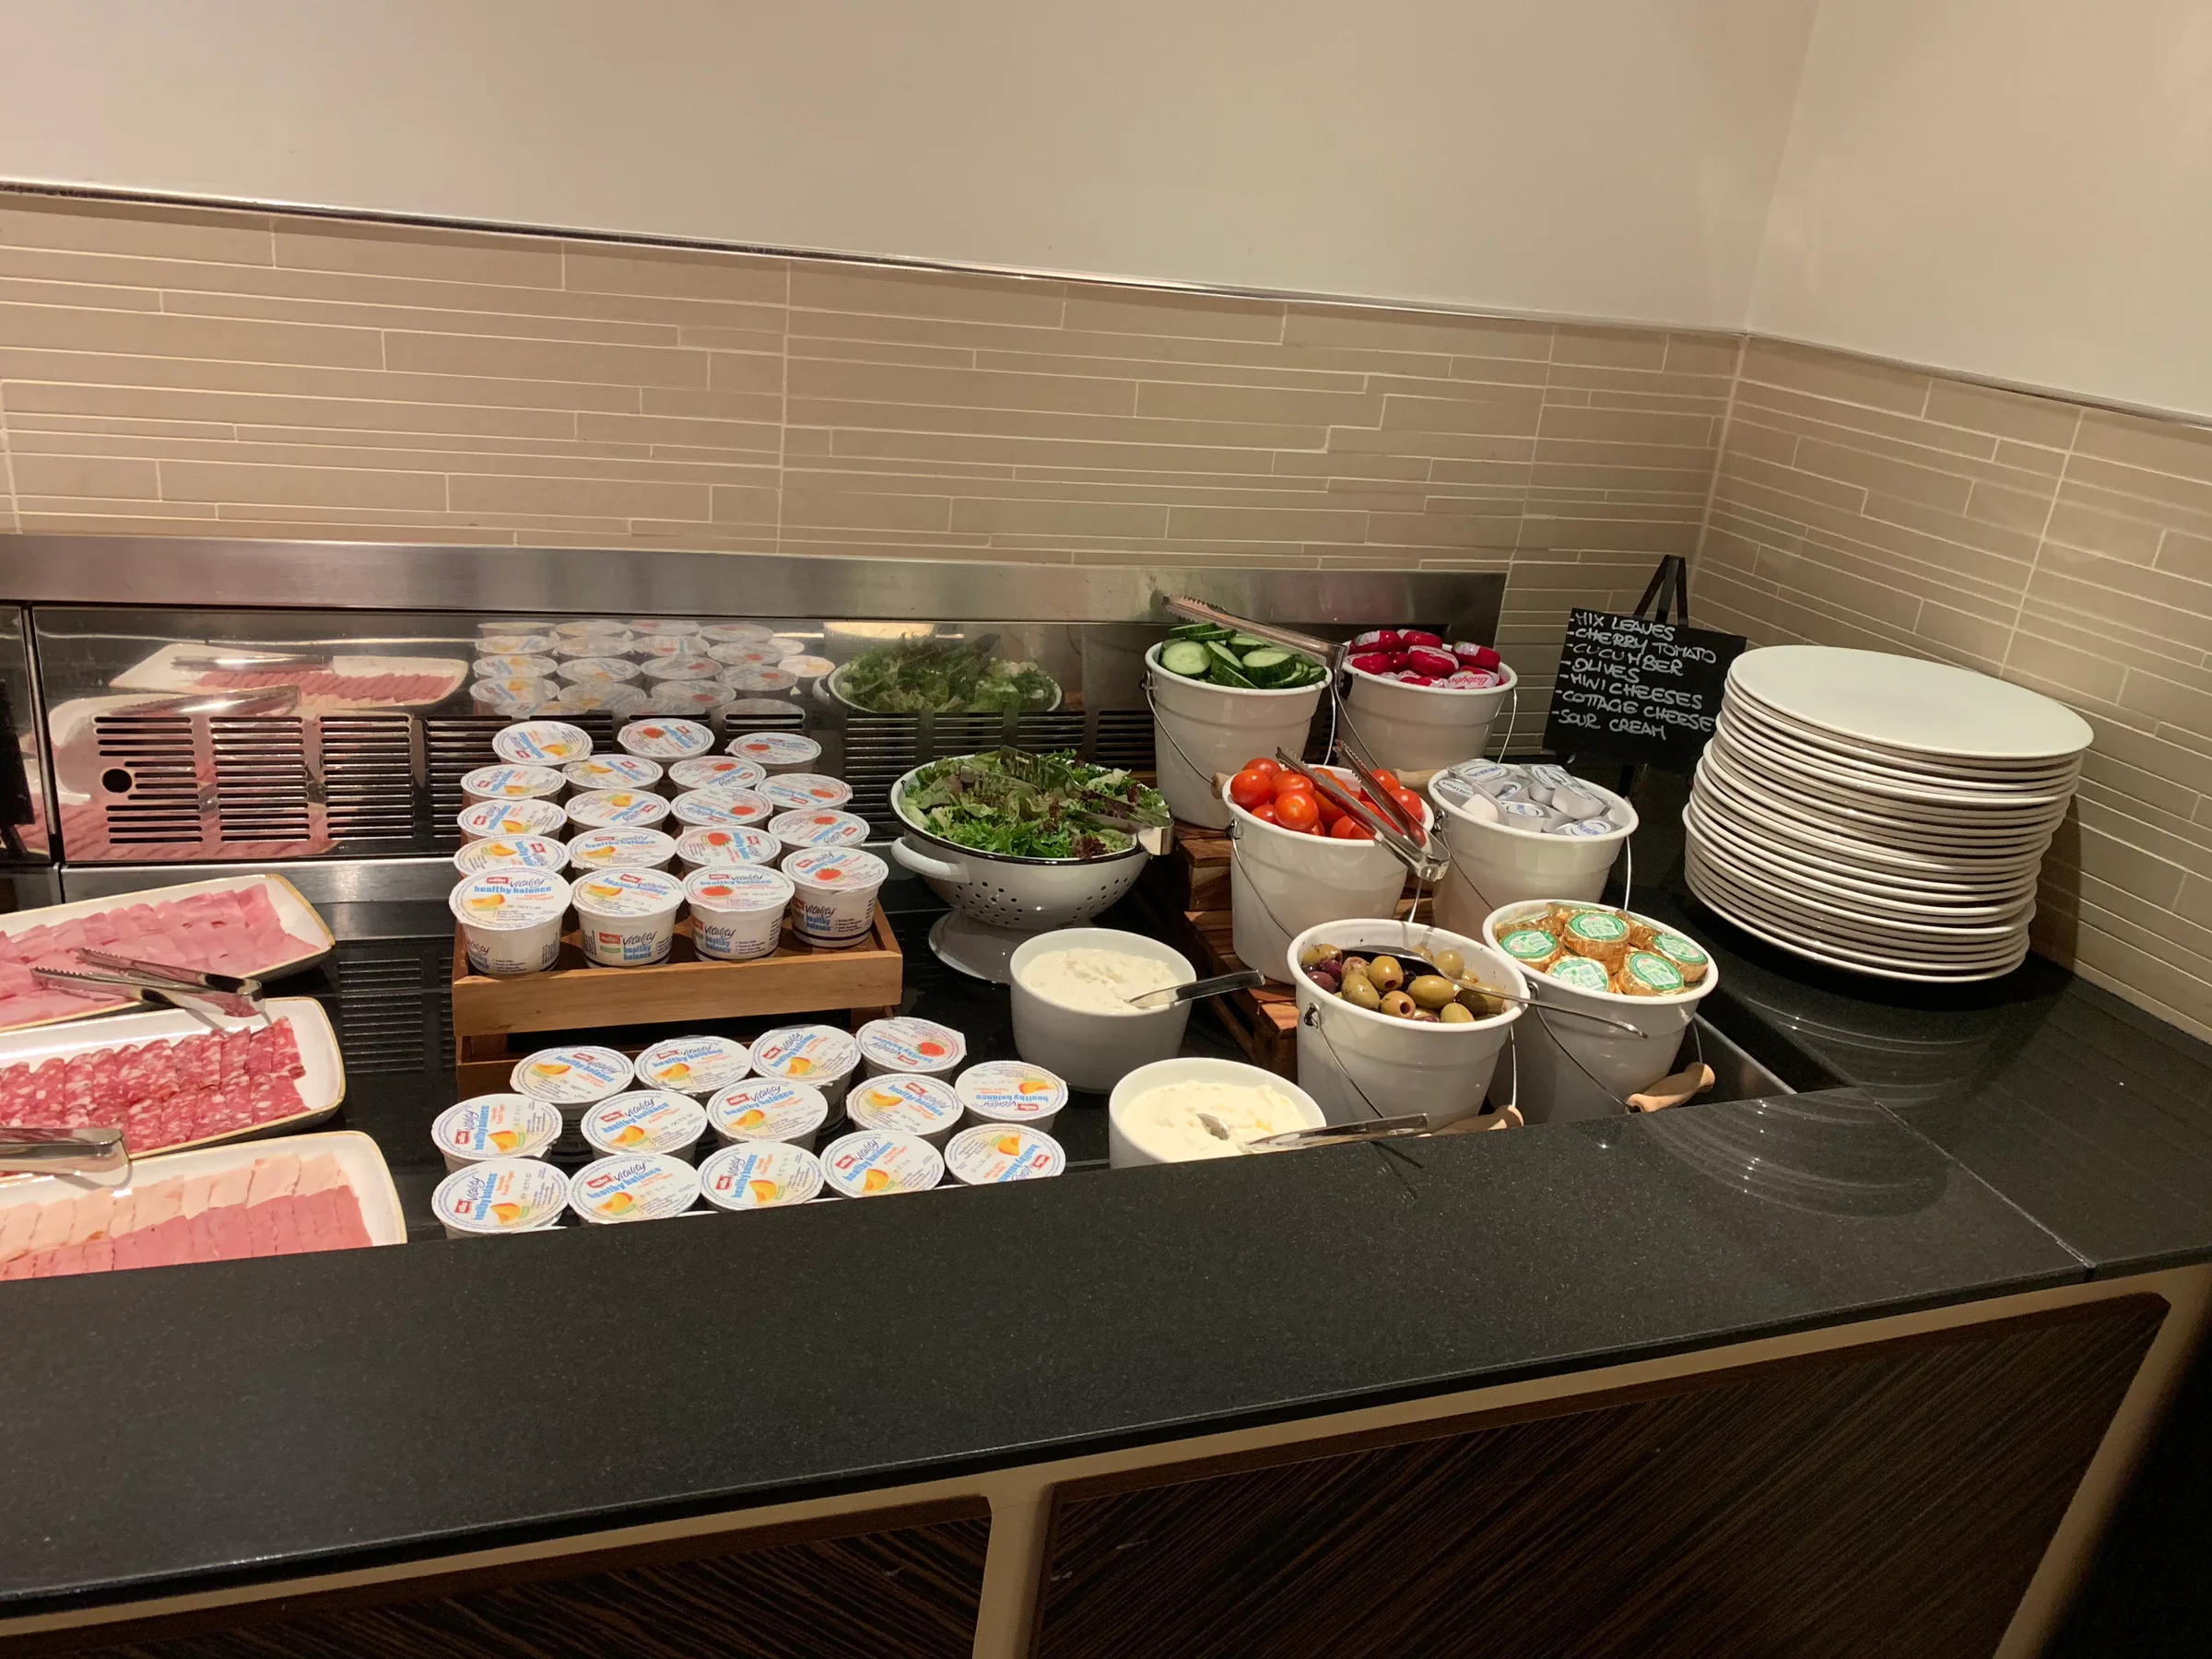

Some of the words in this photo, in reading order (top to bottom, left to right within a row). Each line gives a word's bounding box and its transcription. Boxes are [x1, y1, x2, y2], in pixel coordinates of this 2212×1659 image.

[1611, 617, 1676, 642] LEAVES
[1652, 641, 1717, 664] TOMATO
[1608, 682, 1703, 710] CHEESES
[1643, 705, 1716, 732] CHEESE
[1608, 718, 1667, 741] CREAM
[475, 886, 512, 894] healthy
[513, 886, 551, 894] balance
[511, 878, 545, 888] Vitality
[806, 905, 837, 918] Vitality
[623, 931, 658, 946] Vitality
[705, 925, 736, 939] Vitality
[623, 945, 652, 954] healthy
[623, 952, 652, 960] balance
[724, 1101, 760, 1115] healthy
[759, 1090, 794, 1105] balance
[751, 1086, 781, 1101] Vitality
[625, 1098, 654, 1117] Vitality
[601, 1117, 637, 1134] healthy
[636, 1102, 670, 1120] balance
[614, 1162, 647, 1182] Vitality
[586, 1181, 626, 1200] healthy
[625, 1167, 662, 1185] balance
